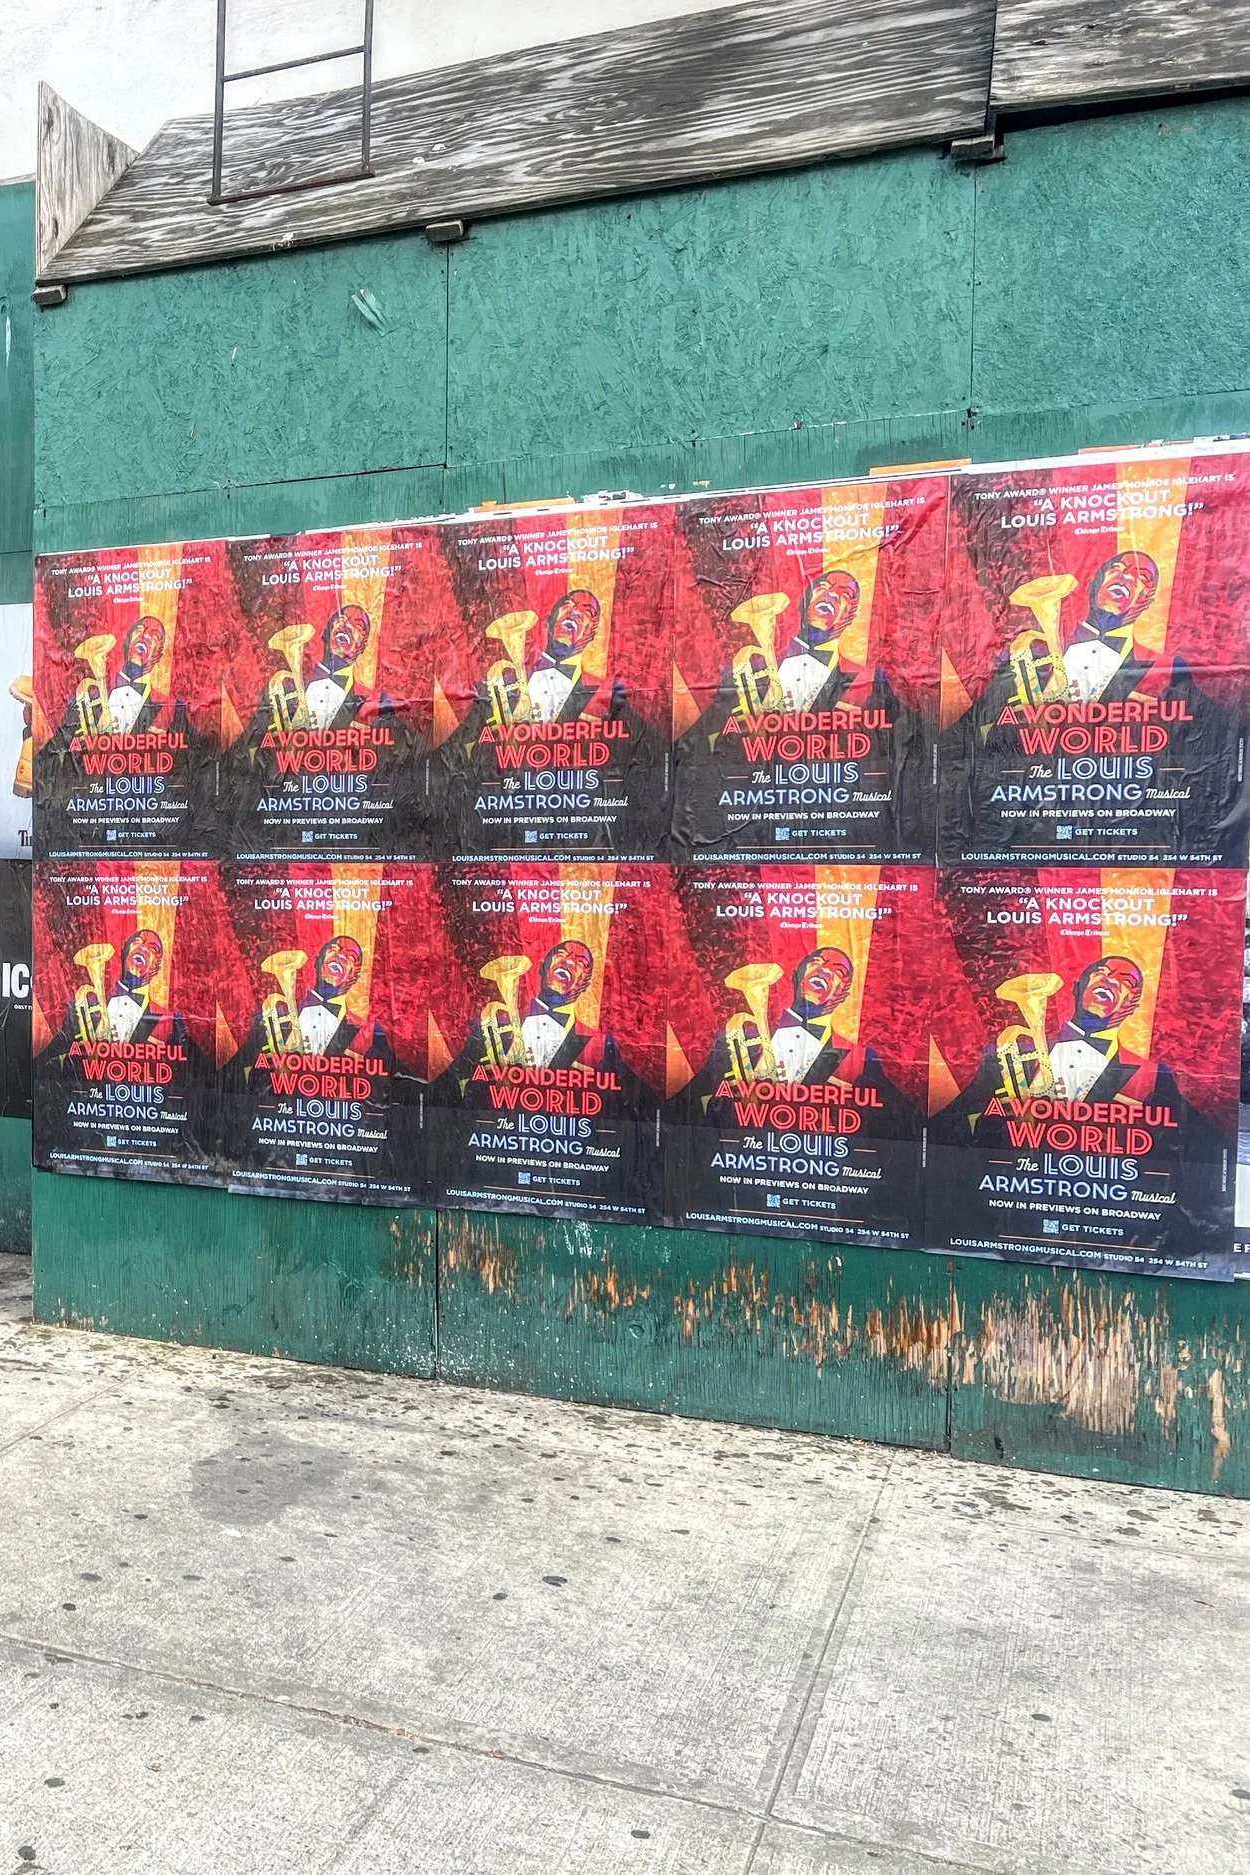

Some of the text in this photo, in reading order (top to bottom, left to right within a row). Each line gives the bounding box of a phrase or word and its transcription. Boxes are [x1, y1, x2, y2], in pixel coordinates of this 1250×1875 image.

[1060, 489, 1172, 510] KNOCKOUT
[1000, 512, 1058, 530] LOUIS
[722, 708, 893, 735] A WONDERFUL
[997, 699, 1195, 726] A WONDERFUL
[68, 732, 189, 753] A WONDERFUL
[260, 728, 396, 749] A WONDERFUL
[477, 719, 630, 744] A WONDERFUL
[1018, 724, 1169, 755] WORLD
[494, 741, 610, 769] WORLD
[741, 732, 872, 762] WORLD
[82, 751, 174, 775] WORLD
[275, 748, 378, 773] WORLD
[1028, 756, 1154, 780] The LOUIS
[282, 774, 368, 794] The LOUIS
[503, 769, 599, 791] The LOUIS
[751, 761, 859, 785] The LOUIS
[89, 776, 165, 795] The LOUIS
[718, 787, 892, 806] ARMSTRONG Musical
[990, 783, 1191, 802] ARMSTRONG Musical
[66, 797, 159, 812] ARMSTRONG
[256, 796, 361, 812] ARMSTRONG
[474, 793, 629, 810] ARMSTRONG Musical
[1001, 808, 1177, 818] NOW IN PREVIEWS ON BROADWAY
[1074, 827, 1139, 836] GET TICKETS
[767, 891, 864, 906] KNOCKOUT
[959, 886, 986, 894] TONY
[1033, 886, 1073, 895] WINNER
[1075, 887, 1108, 895] JAMES
[1110, 887, 1153, 895] MONROE
[1156, 887, 1206, 896] IGLEHART
[1208, 888, 1218, 896] IS
[716, 904, 765, 918] LOUIS
[1045, 896, 1155, 912] KNOCKOUT
[986, 910, 1043, 925] LOUIS
[68, 1040, 188, 1062] A WONDERFUL
[82, 1058, 173, 1085] WORLD
[254, 1052, 389, 1077] A WONDERFUL
[269, 1071, 372, 1101] WORLD
[471, 1064, 622, 1091] A WONDERFUL
[89, 1083, 164, 1105] The LOUIS
[488, 1084, 603, 1117] WORLD
[715, 1079, 885, 1109] A WONDERFUL
[66, 1100, 158, 1121] ARMSTRONG
[277, 1097, 362, 1122] The LOUIS
[734, 1100, 863, 1136] WORLD
[983, 1096, 1179, 1128] A WONDERFUL
[251, 1115, 355, 1139] ARMSTRONG
[496, 1112, 592, 1139] The LOUIS
[467, 1131, 621, 1159] ARMSTRONG Musical
[742, 1131, 850, 1159] The LOUIS
[1005, 1119, 1154, 1157] WORLD
[710, 1150, 882, 1180] ARMSTRONG Musical
[1015, 1151, 1139, 1182] The LOUIS
[978, 1172, 1176, 1205] ARMSTRONG Musical
[988, 1198, 1162, 1221] NOW IN PREVIEWS ON BROADWAY
[1061, 1222, 1124, 1236] GET TICKETS
